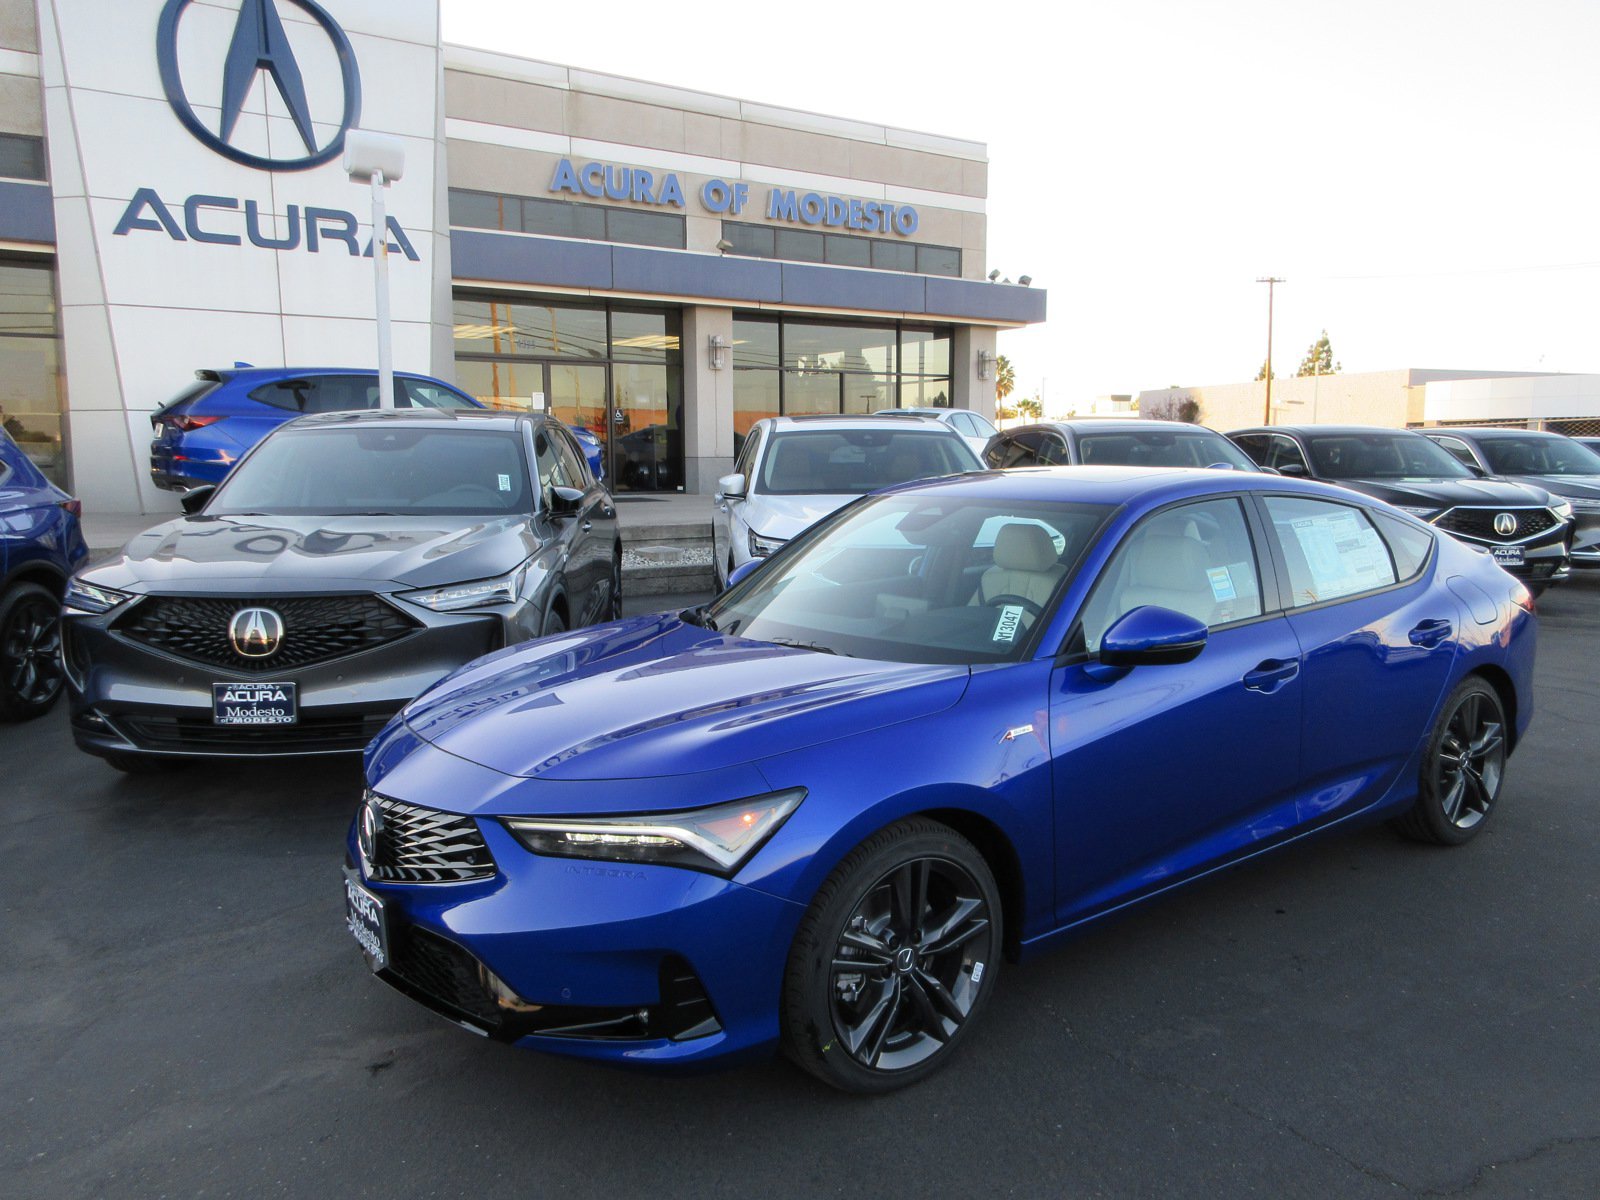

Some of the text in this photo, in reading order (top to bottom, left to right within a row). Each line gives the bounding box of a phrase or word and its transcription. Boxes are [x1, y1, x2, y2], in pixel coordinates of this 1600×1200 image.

[549, 158, 919, 236] ACURA OF MODESTO
[112, 187, 420, 261] ACURA
[223, 691, 287, 702] ACURA
[226, 706, 285, 717] Modesto
